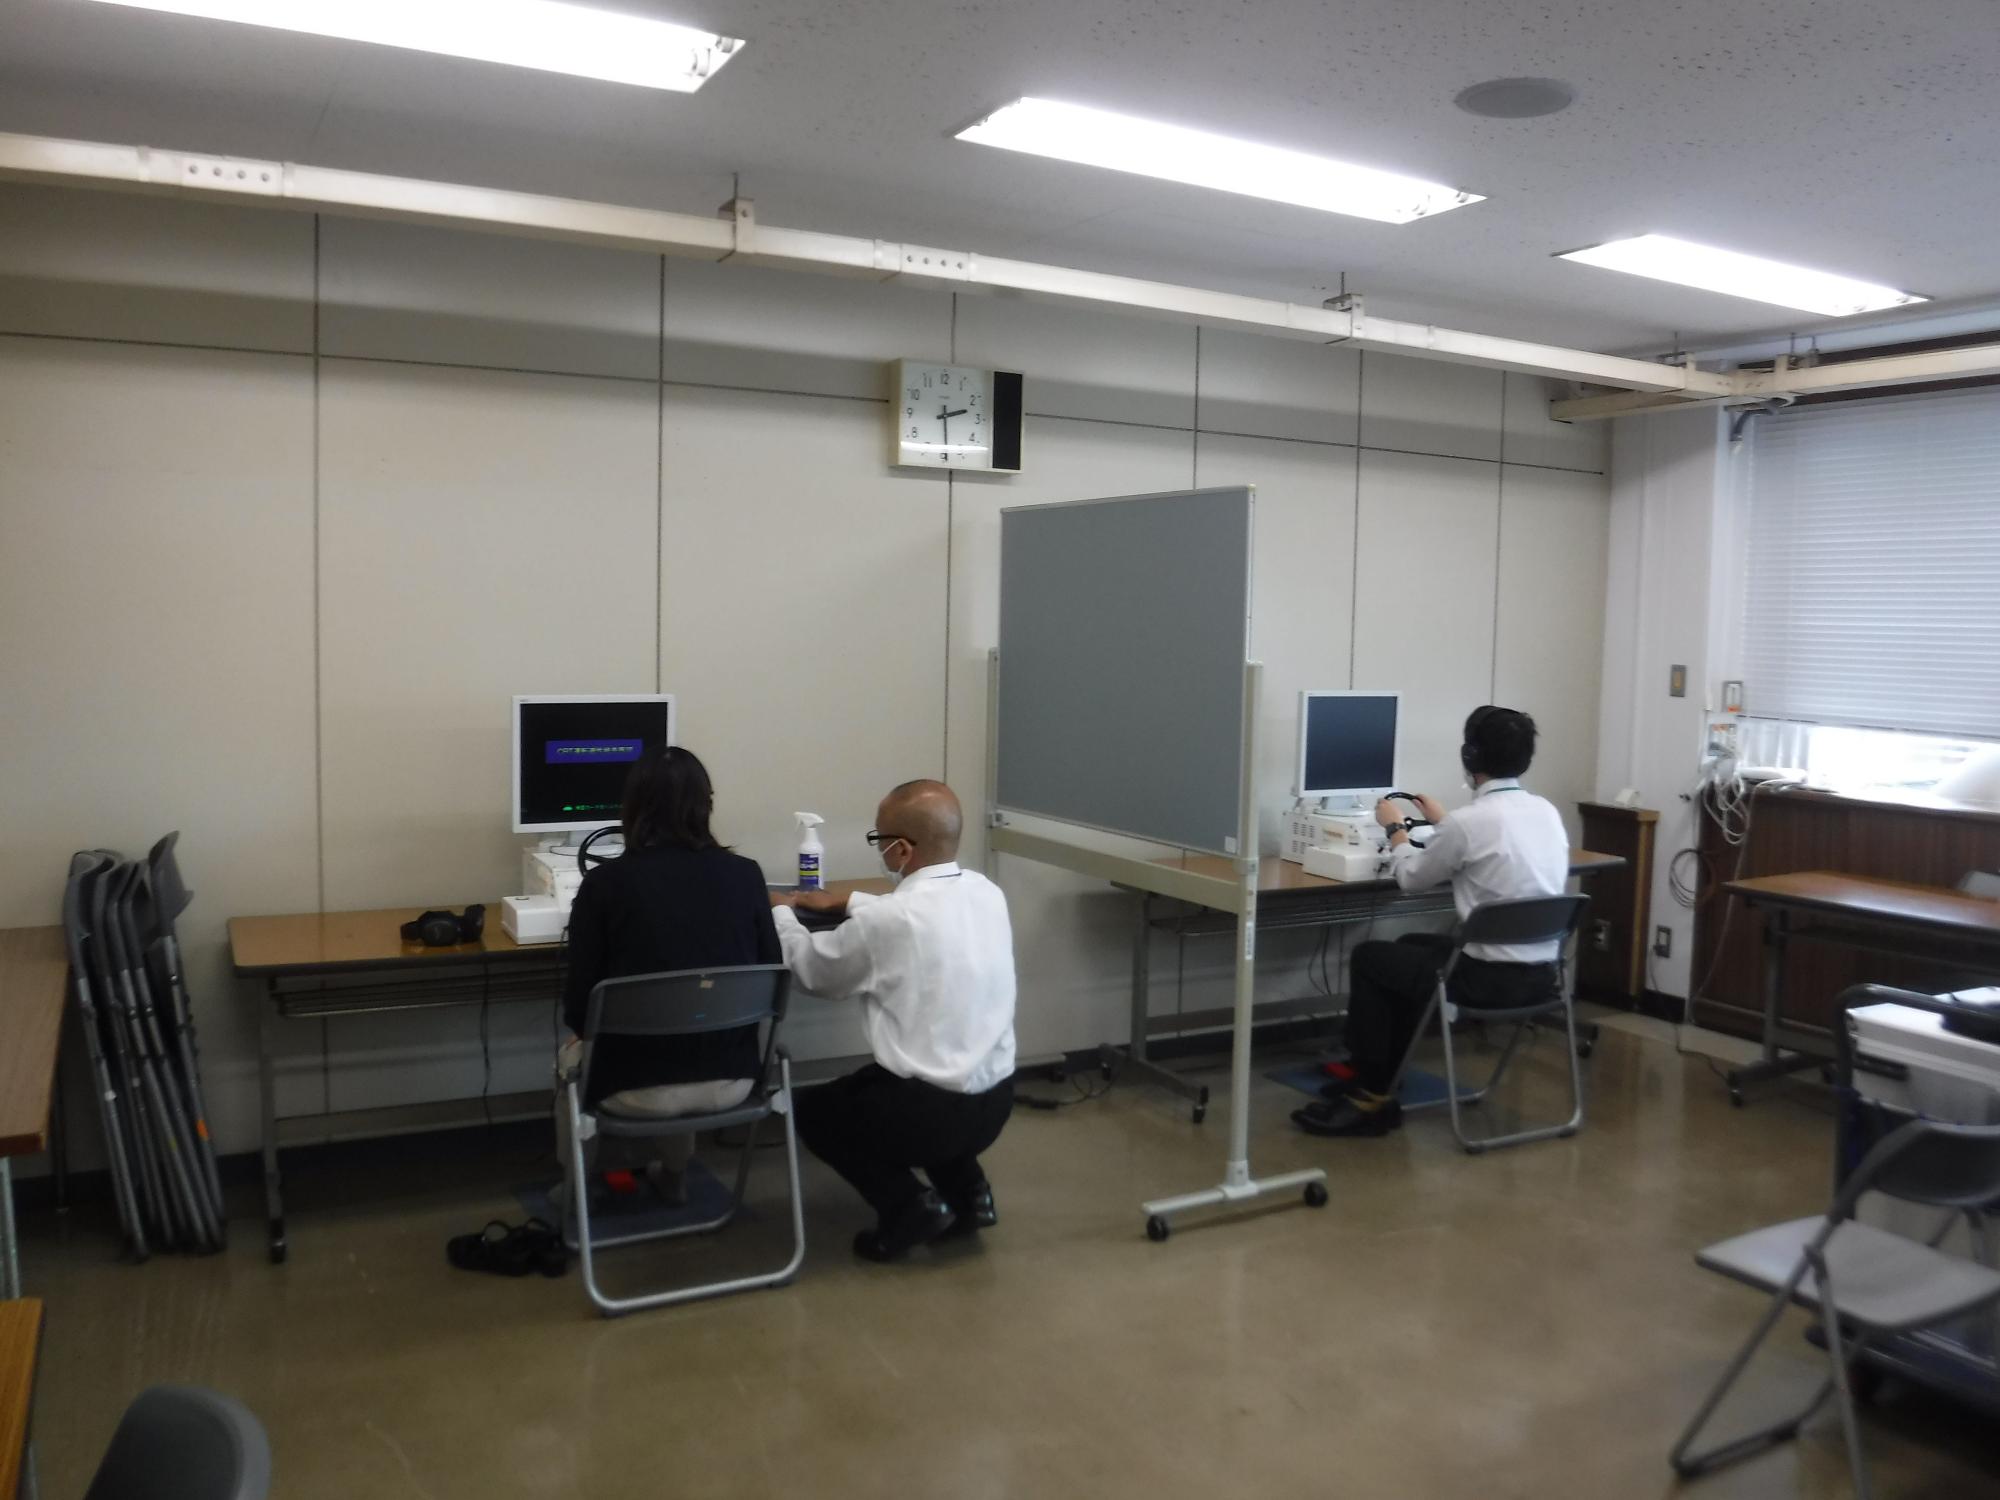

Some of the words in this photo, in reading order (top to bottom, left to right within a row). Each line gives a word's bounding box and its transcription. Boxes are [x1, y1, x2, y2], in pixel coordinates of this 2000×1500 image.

[923, 376, 933, 388] 11
[940, 373, 950, 385] 12
[911, 388, 920, 401] 10
[969, 394, 977, 406] 2
[906, 407, 913, 418] 9
[975, 413, 981, 425] 3
[911, 426, 918, 438] 8
[968, 432, 976, 442] 4
